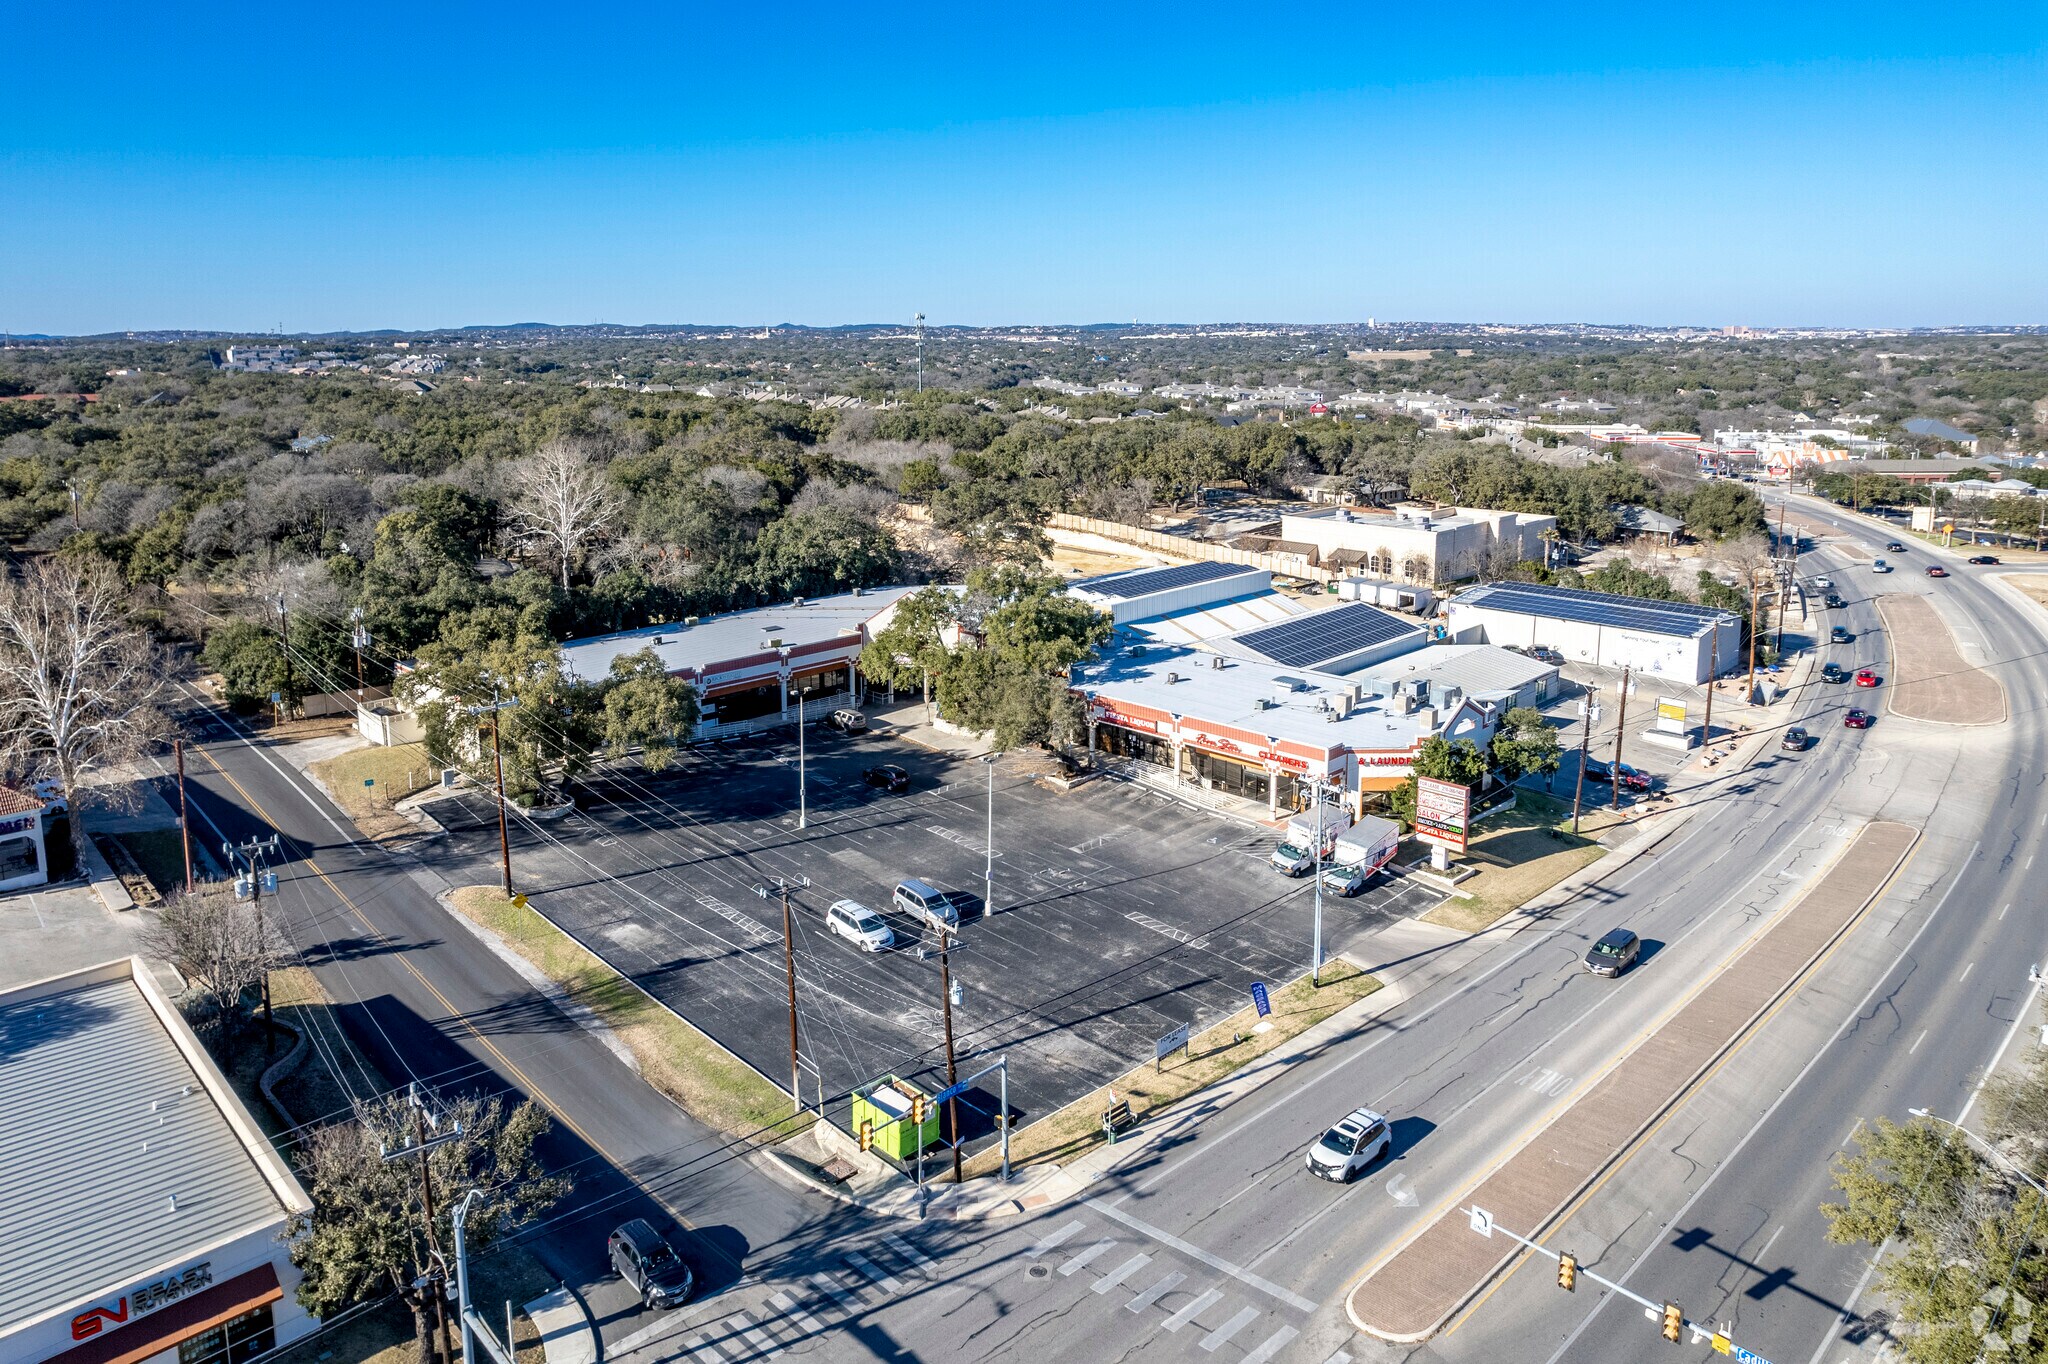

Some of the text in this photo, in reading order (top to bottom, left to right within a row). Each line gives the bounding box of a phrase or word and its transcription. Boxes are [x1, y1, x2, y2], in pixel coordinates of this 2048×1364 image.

[1105, 711, 1156, 730] FIESTA LIQUOR
[1258, 751, 1309, 769] CLEANERS
[1358, 757, 1415, 766] & LAUNDR
[1417, 808, 1441, 821] SALON
[1417, 825, 1463, 842] FIESTA LIQUOR
[1160, 1034, 1171, 1043] FOR
[937, 1086, 957, 1103] Blanco
[1473, 1223, 1488, 1235] ONLY
[131, 1261, 211, 1306] BEAST
[132, 1272, 213, 1316] NUTRITION
